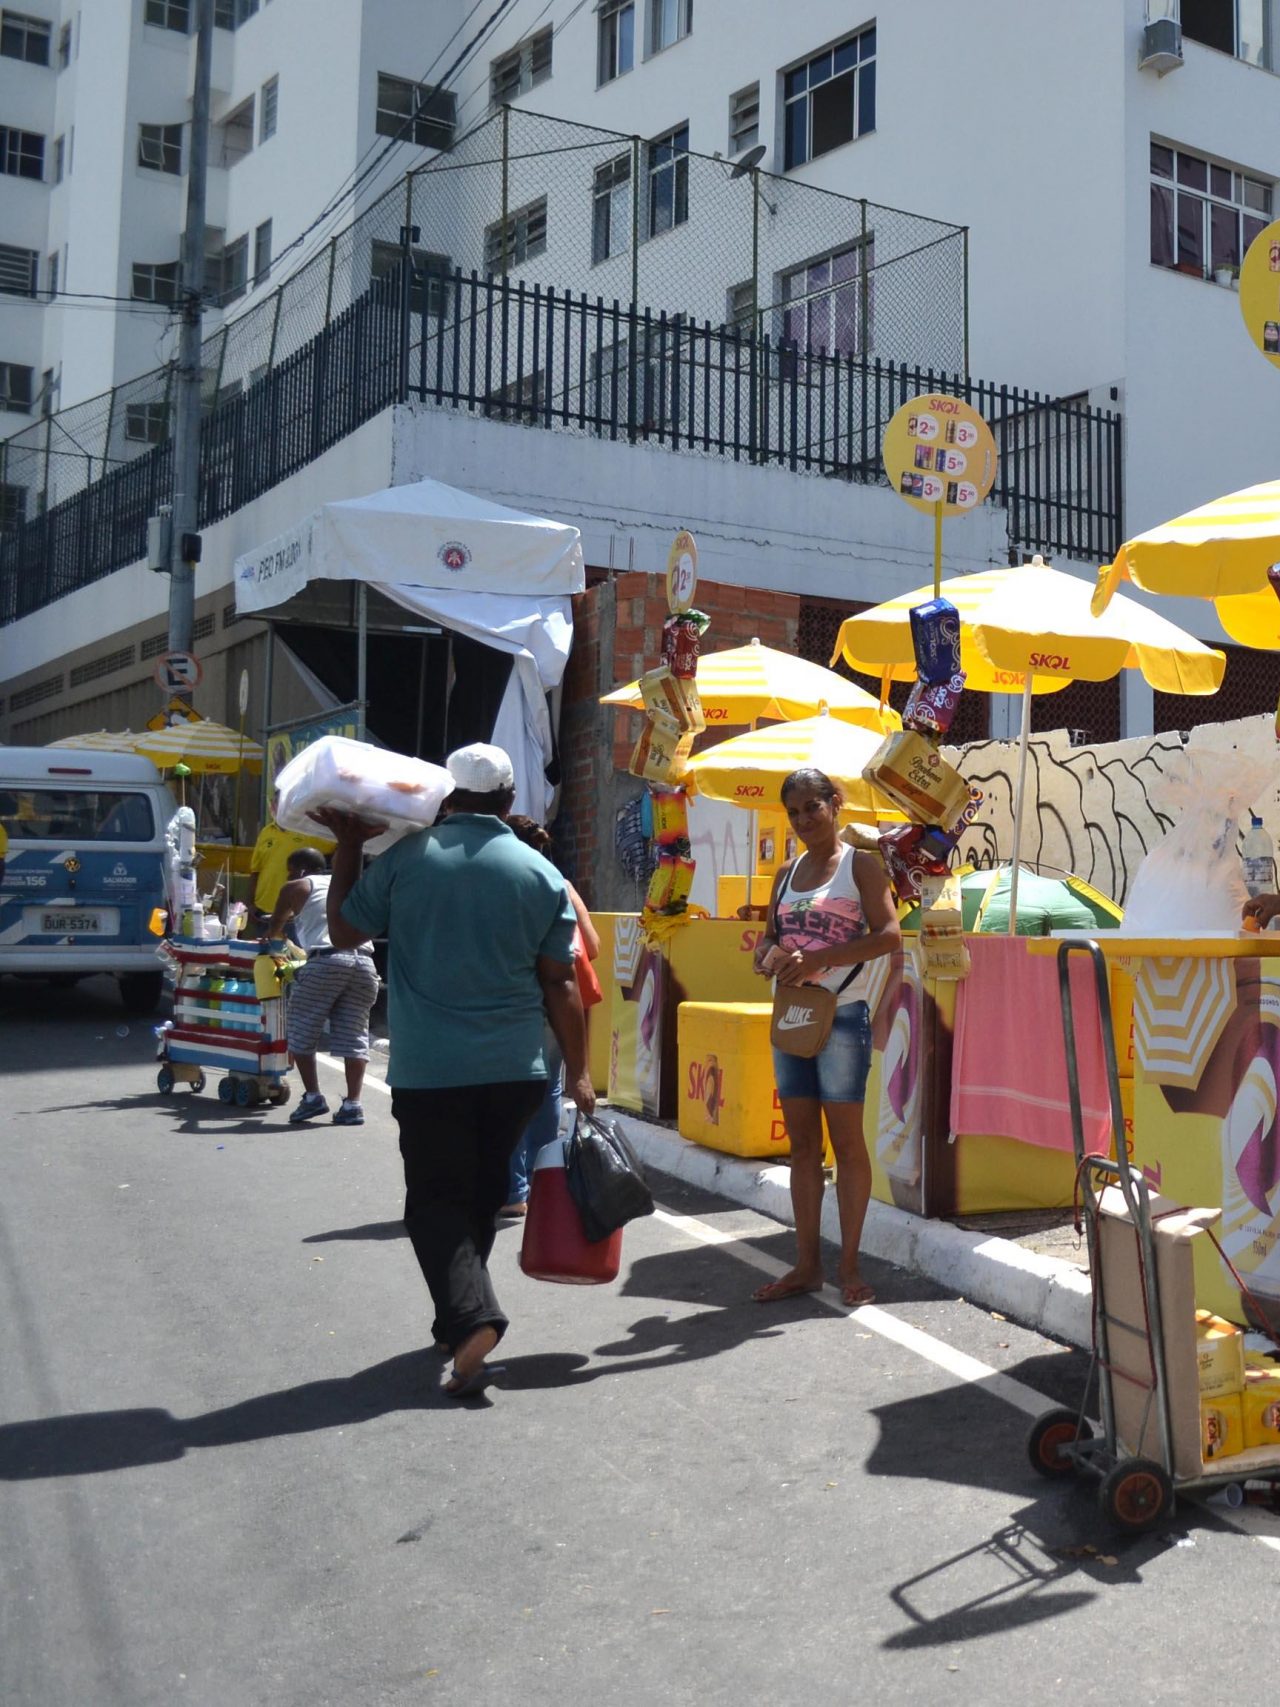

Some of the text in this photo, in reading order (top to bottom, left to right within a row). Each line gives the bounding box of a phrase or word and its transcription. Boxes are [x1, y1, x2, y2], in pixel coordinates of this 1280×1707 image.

[929, 399, 960, 415] SKOL
[1029, 653, 1071, 669] SKOL
[734, 785, 765, 797] SKOL
[785, 1005, 814, 1023] NIKE
